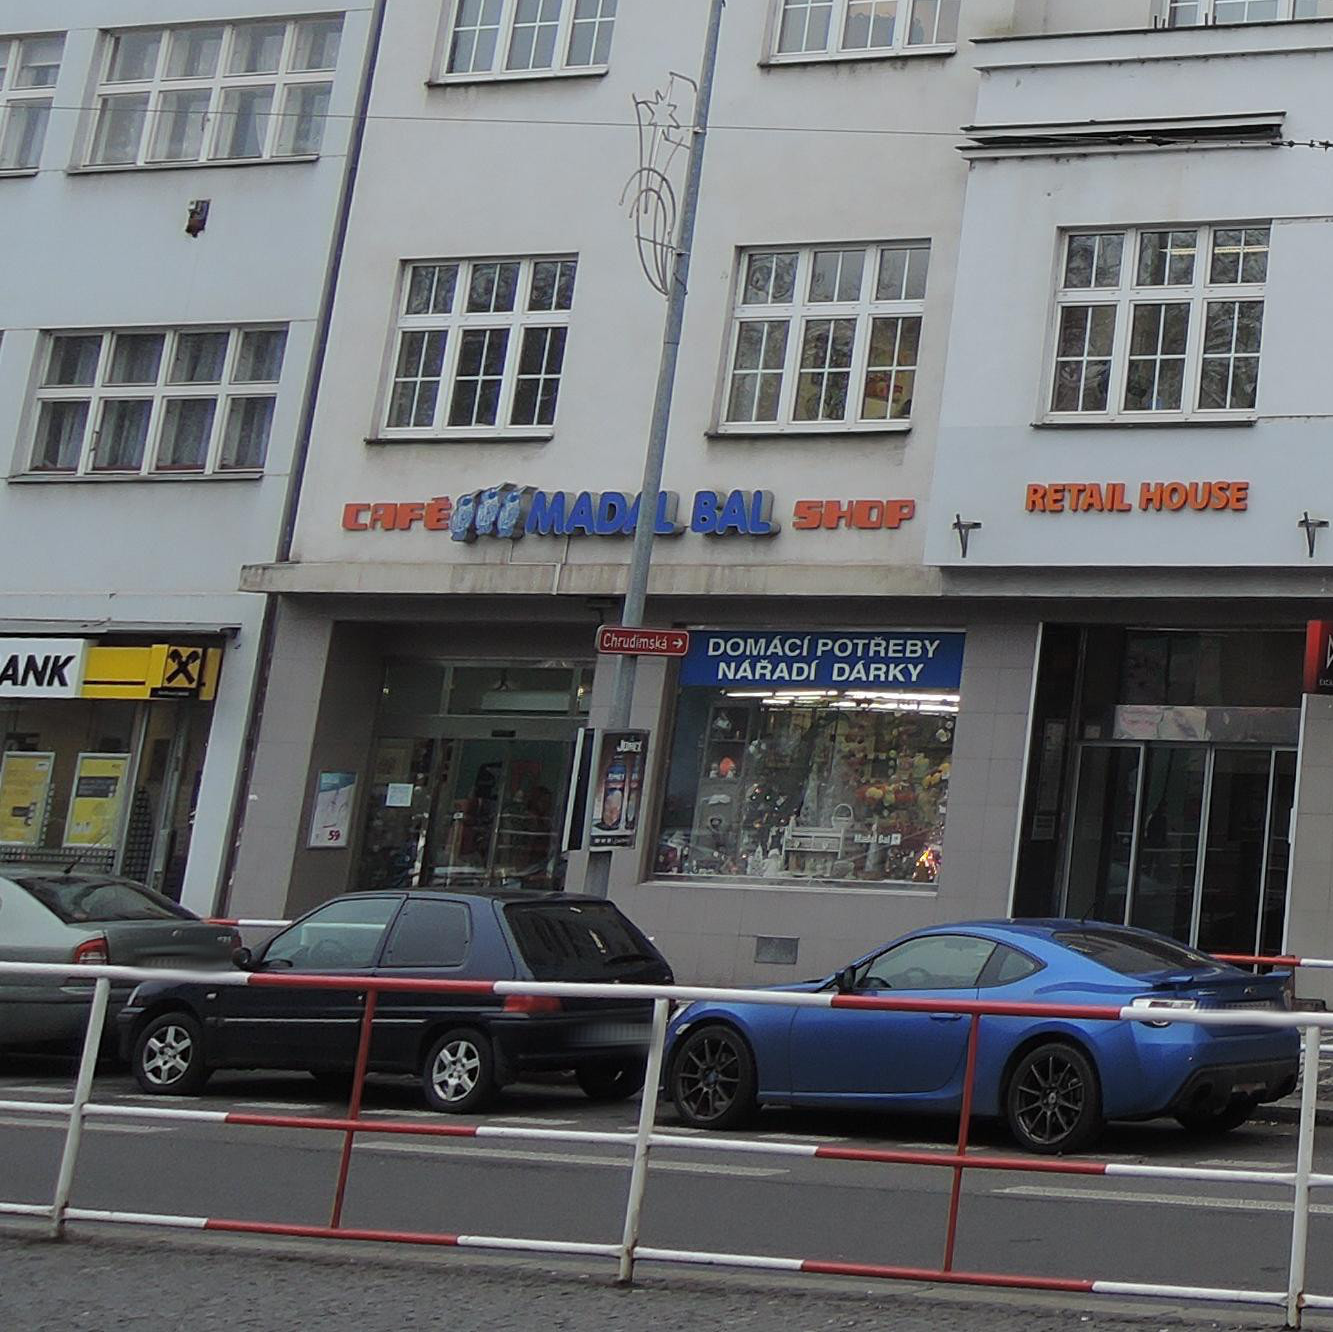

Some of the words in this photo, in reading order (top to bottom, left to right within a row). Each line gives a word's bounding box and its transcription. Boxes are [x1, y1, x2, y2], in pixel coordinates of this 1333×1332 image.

[1025, 482, 1133, 512] RETAIL
[1138, 481, 1250, 511] HOUSE
[341, 496, 453, 531] CAFÉ
[691, 489, 776, 536] BAL
[793, 499, 916, 530] SHOP
[603, 632, 668, 650] Chrudimská
[707, 635, 811, 658] DOMÁCÍ
[816, 636, 942, 659] POTŘEBY
[717, 658, 820, 682] NÁŘADÍ
[831, 660, 925, 683] DÁRKY
